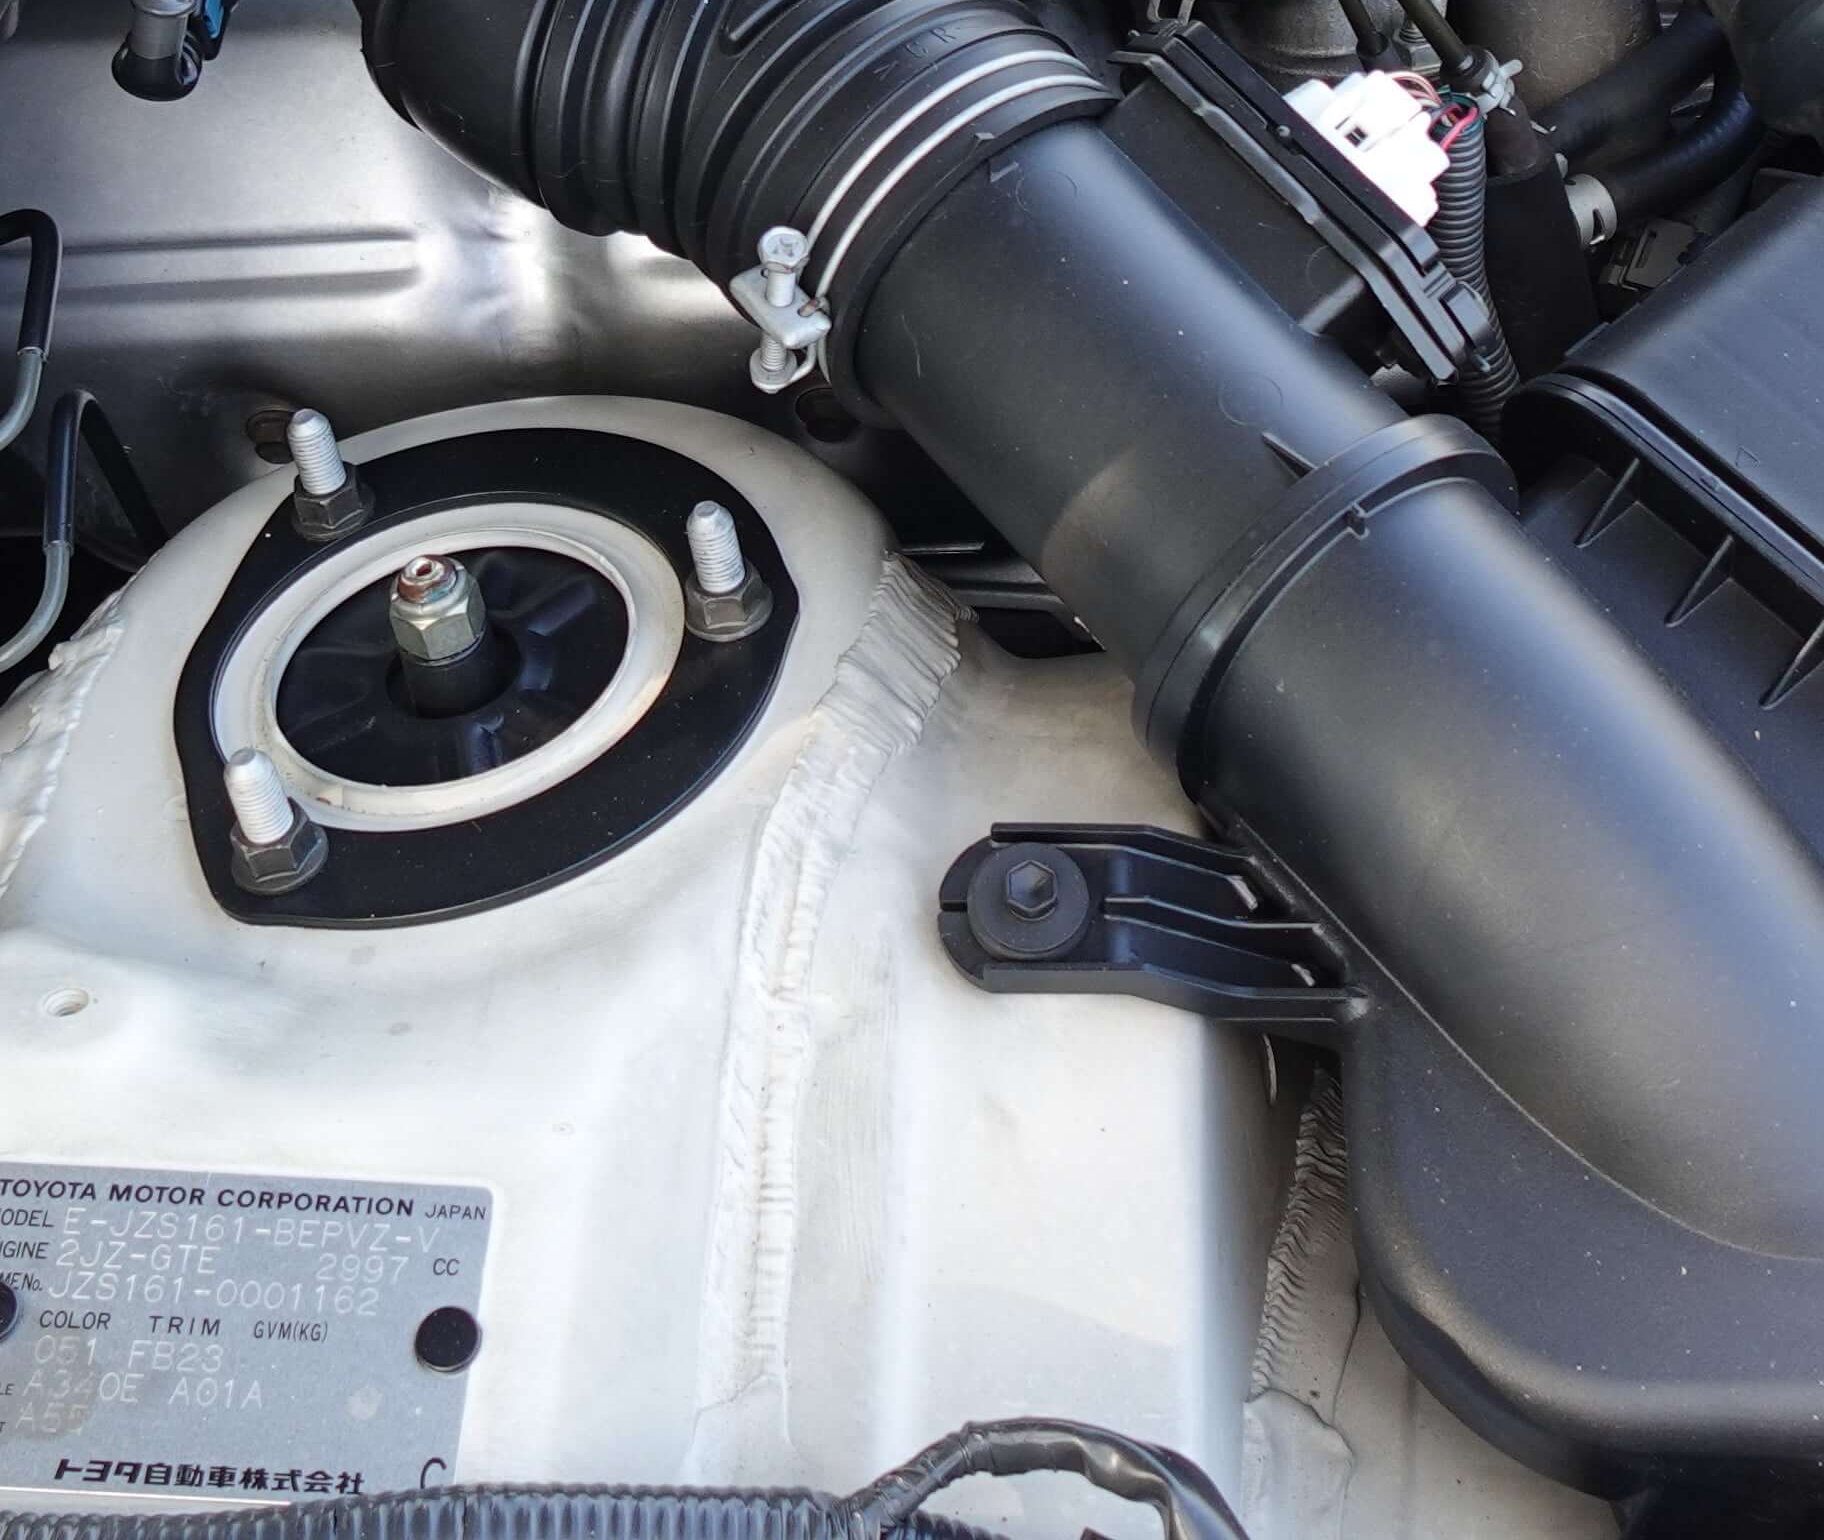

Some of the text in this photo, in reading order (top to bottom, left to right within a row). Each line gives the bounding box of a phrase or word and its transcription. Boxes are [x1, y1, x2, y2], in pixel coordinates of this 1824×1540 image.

[108, 1183, 206, 1207] MOTOR
[216, 1188, 415, 1218] CORPORATION
[424, 1203, 487, 1220] JAPAN
[55, 1237, 222, 1275] 2JZ-GTE
[314, 1252, 410, 1285] 2997
[432, 1257, 461, 1277] CC
[47, 1270, 380, 1317] JZS161-0001162
[38, 1310, 330, 1343] COLOR TRIM GVM(KG)
[34, 1334, 224, 1373] 051 FB23
[167, 1378, 264, 1410] A01A
[53, 1458, 365, 1495] トヨタ自動車株式会社
